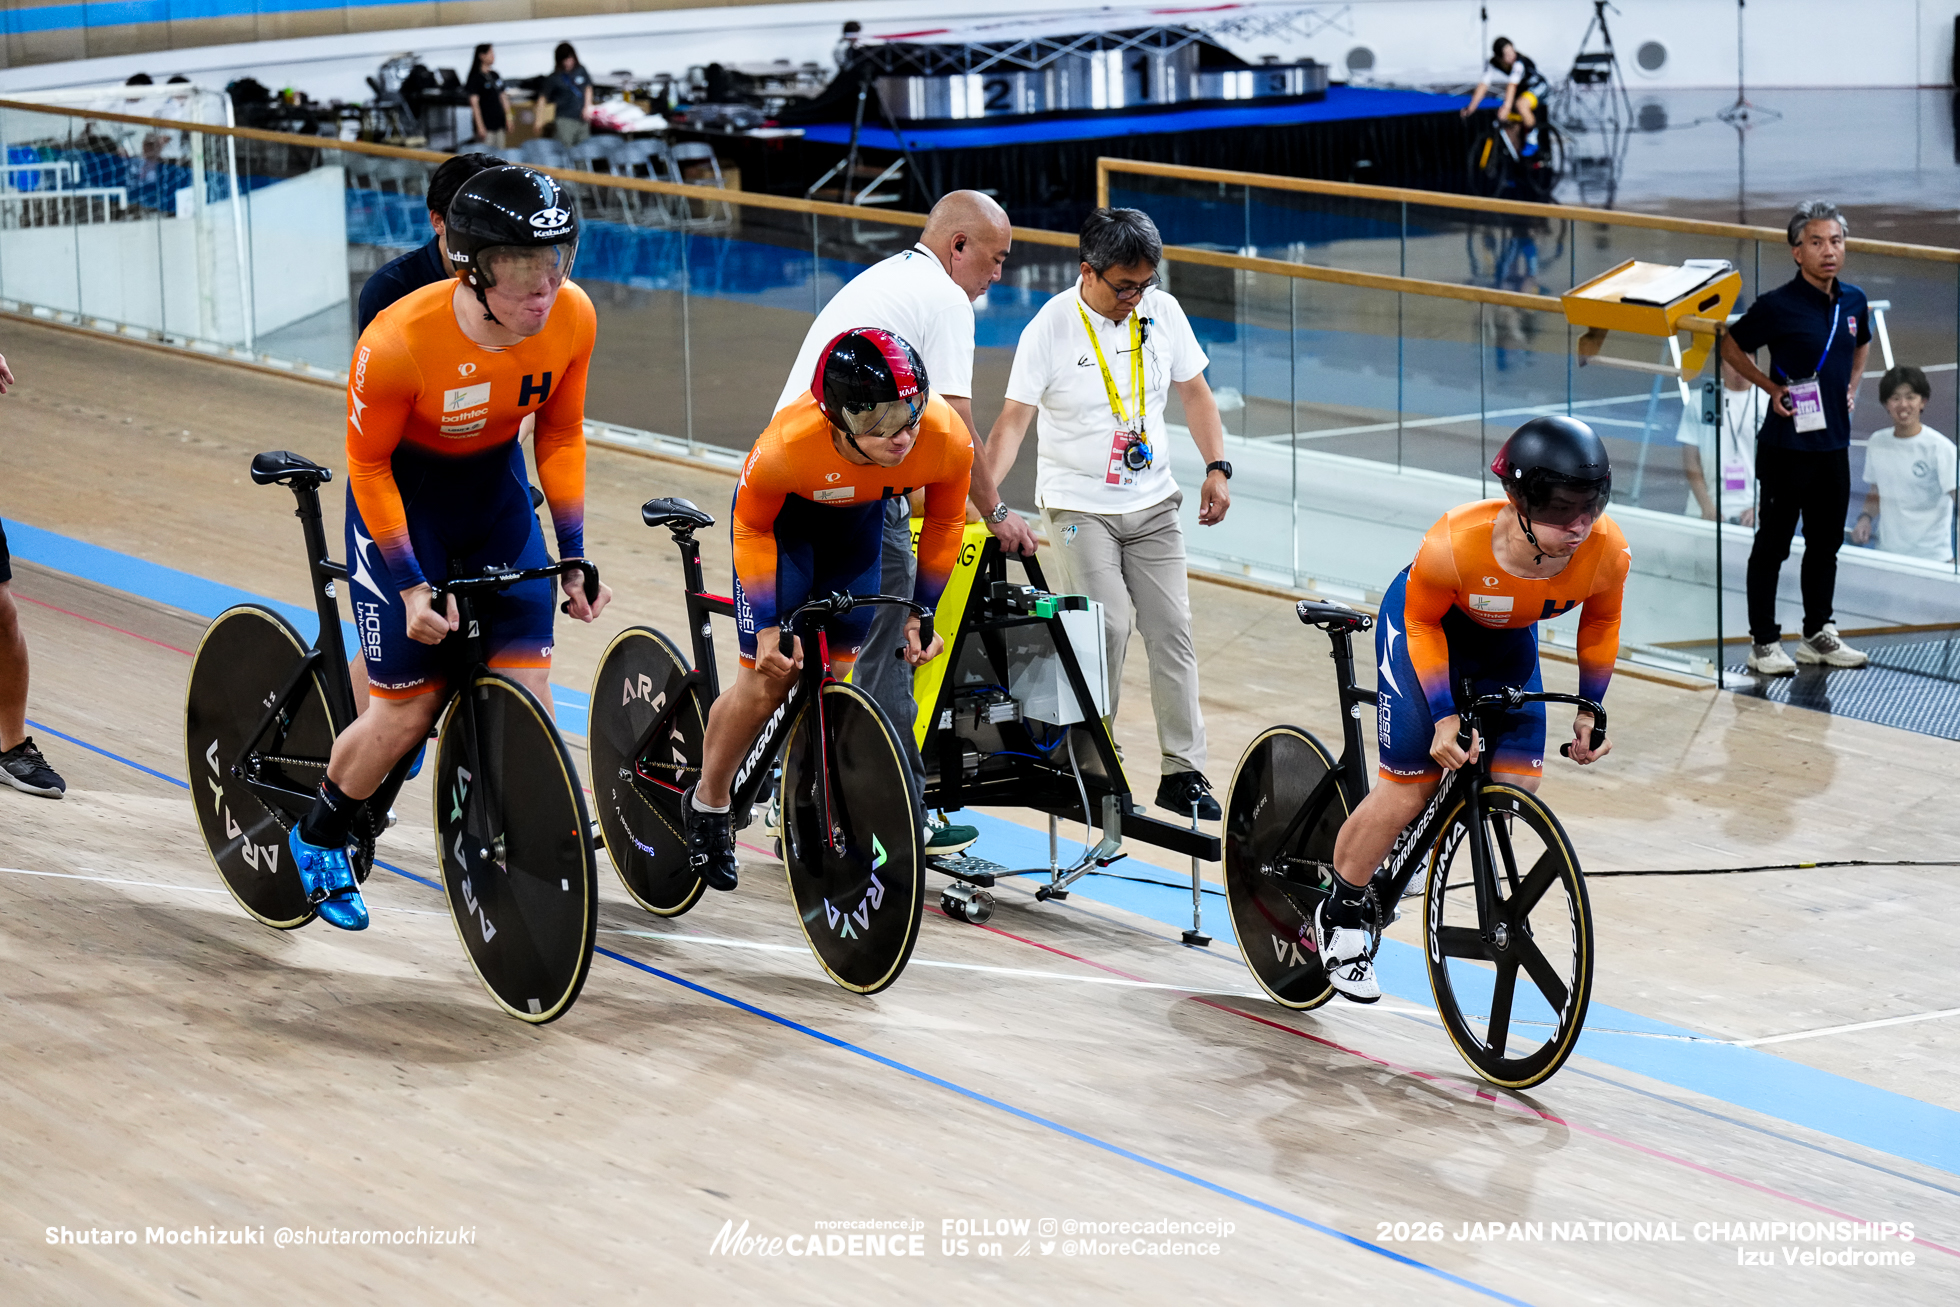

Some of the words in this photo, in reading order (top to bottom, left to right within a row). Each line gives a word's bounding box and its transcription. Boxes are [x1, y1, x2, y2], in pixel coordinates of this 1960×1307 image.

[983, 79, 1010, 111] 2
[355, 345, 371, 393] HOSEI
[517, 371, 552, 407] H
[441, 407, 489, 423] bathtec
[364, 602, 382, 662] HOSEI
[392, 677, 425, 689] IZUMI
[1381, 694, 1392, 749] HOSEI
[734, 703, 786, 796] ARGON
[824, 832, 888, 940] ARAYA
[1429, 821, 1467, 964] CORIMA
